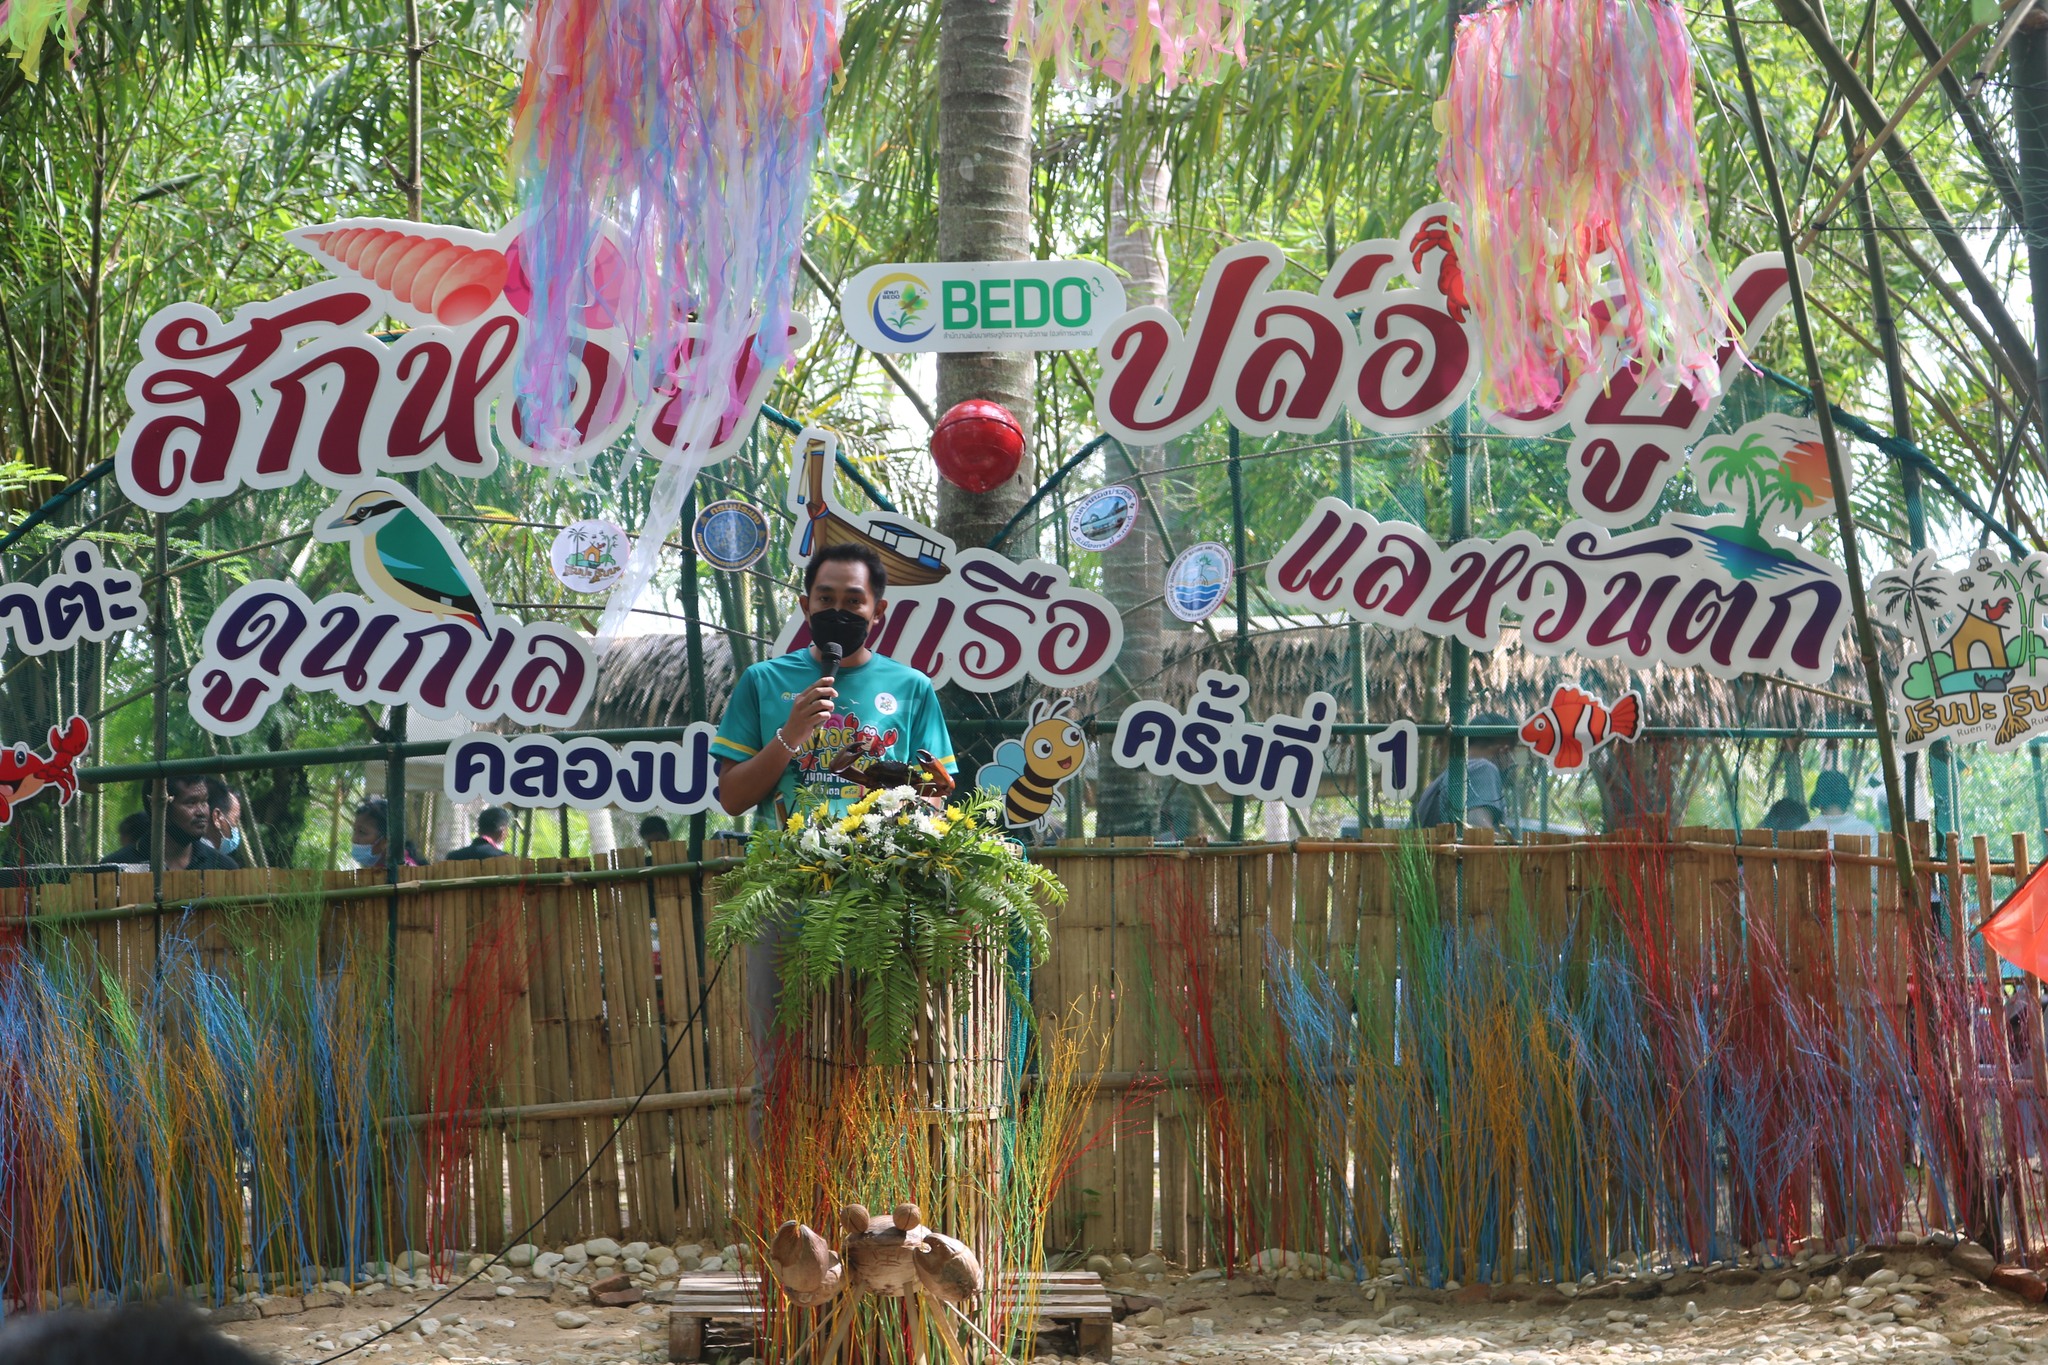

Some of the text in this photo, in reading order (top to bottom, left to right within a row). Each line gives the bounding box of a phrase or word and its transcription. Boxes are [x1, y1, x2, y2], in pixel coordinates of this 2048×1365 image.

[943, 277, 1092, 330] BEDO
[1277, 510, 1842, 670] แลหวันตก
[202, 593, 586, 723] ดูนกเล
[454, 731, 721, 805] คลองป
[1122, 679, 1408, 799] ครั้งที่ 1
[1956, 725, 1983, 738] Ruen
[1985, 722, 1998, 732] Pa
